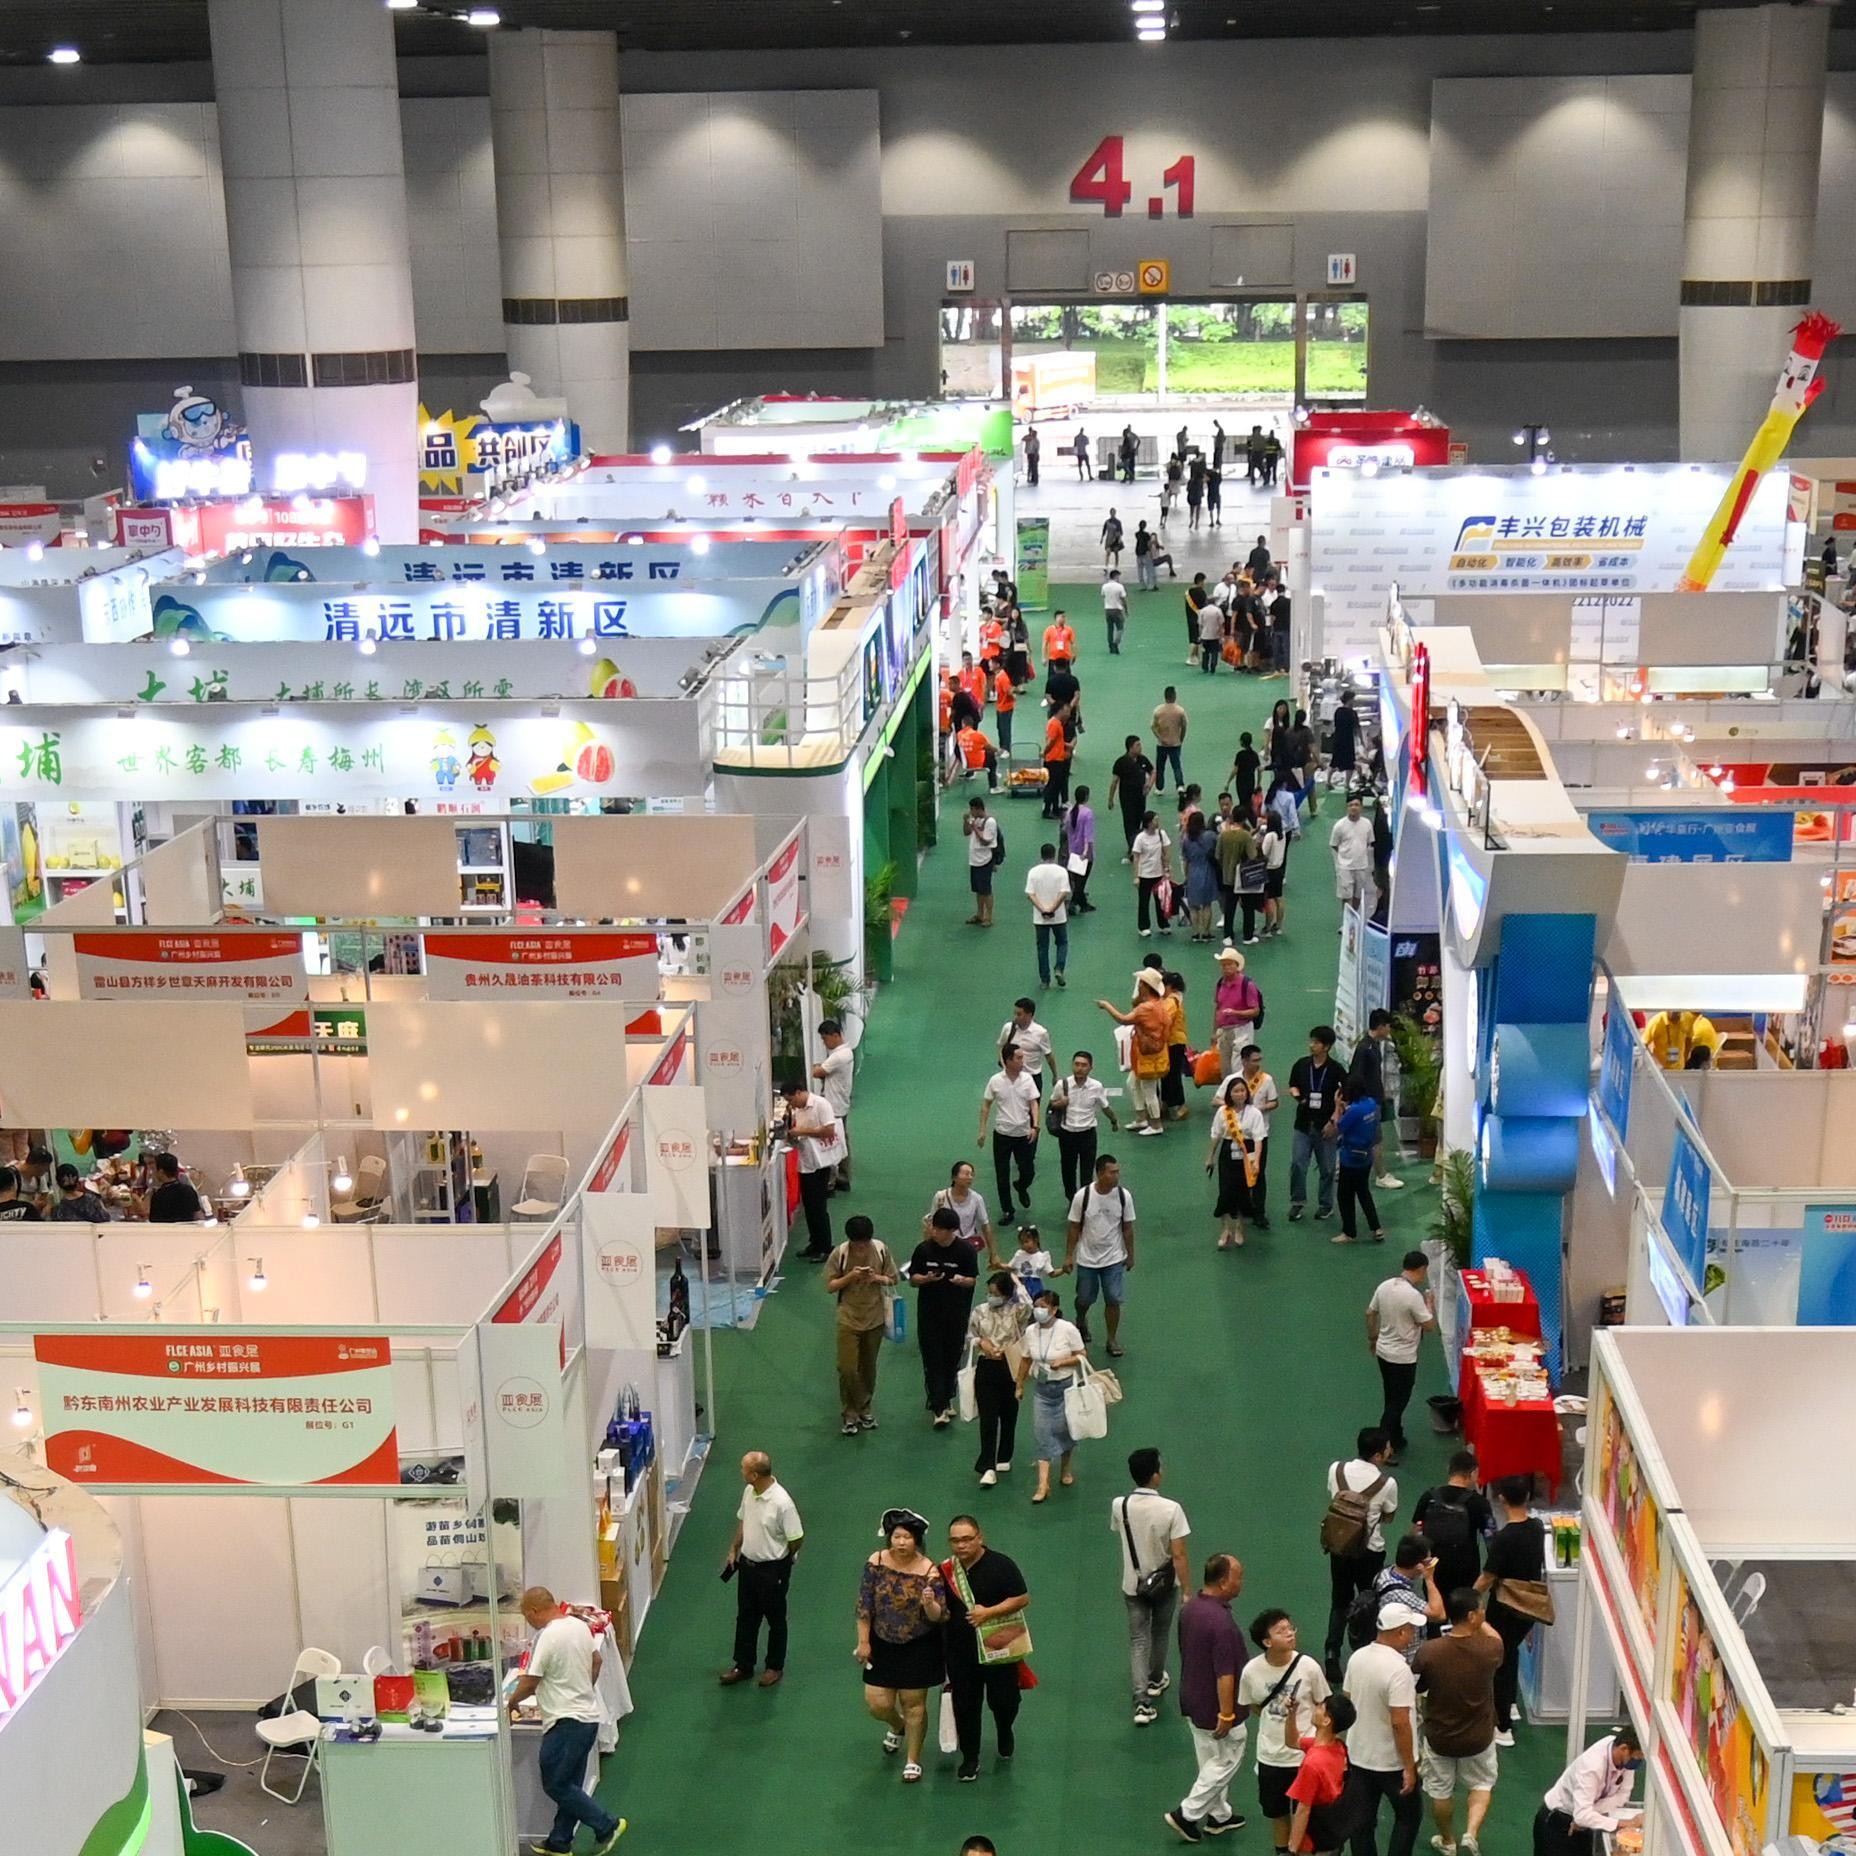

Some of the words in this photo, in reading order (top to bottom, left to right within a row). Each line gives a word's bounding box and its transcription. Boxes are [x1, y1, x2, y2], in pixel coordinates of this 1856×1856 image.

[1070, 136, 1195, 218] 4.1
[1497, 515, 1648, 538] 丰兴包装机械
[1456, 557, 1488, 568] 自动化
[324, 601, 630, 641] 清远市清新区
[117, 742, 244, 776] 世界客都
[263, 742, 385, 777] 长寿梅州
[660, 1142, 693, 1155] 亚食展
[601, 1256, 638, 1268] 亚食展
[165, 1344, 189, 1358] FLCE
[190, 1344, 214, 1358] ASIA
[218, 1343, 259, 1359] 亚食展
[183, 1361, 261, 1374] 广州乡村振兴展
[63, 1394, 373, 1416] 黔东南州农业产业发展科技有限责任公司
[501, 1392, 543, 1407] 亚食展
